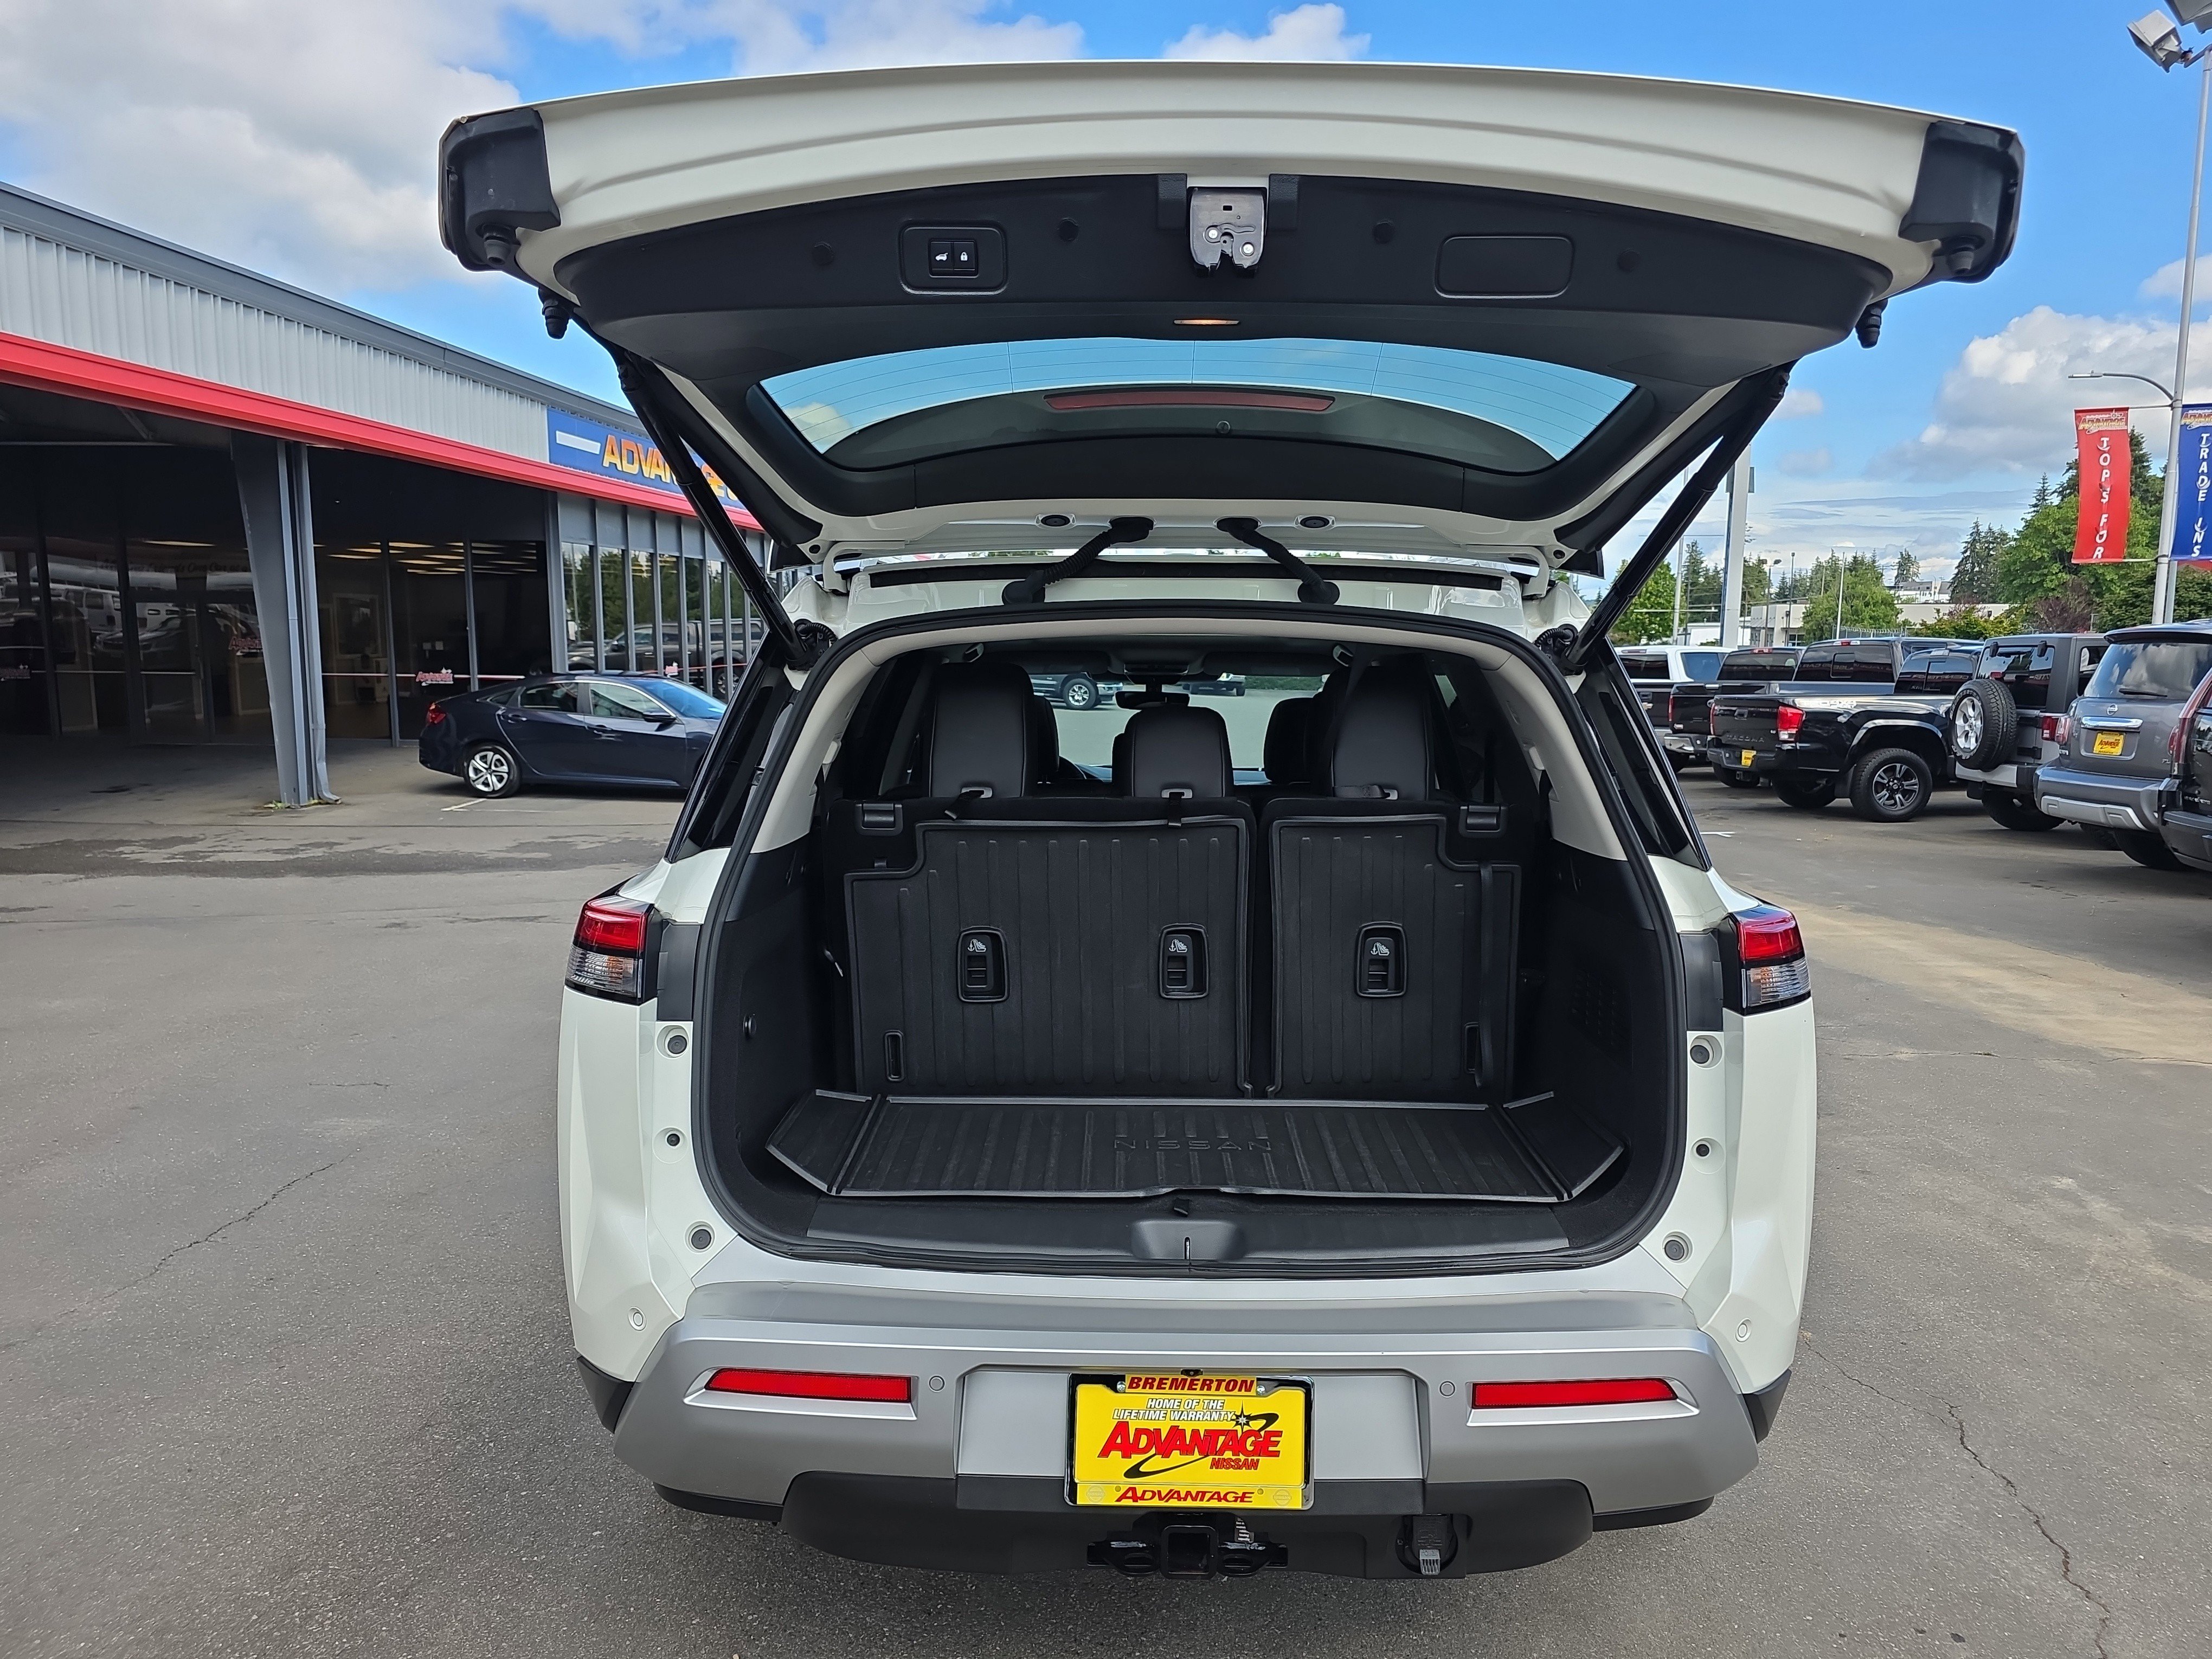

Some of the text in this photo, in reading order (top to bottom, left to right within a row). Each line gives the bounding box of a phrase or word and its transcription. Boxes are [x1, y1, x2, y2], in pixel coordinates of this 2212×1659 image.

[2078, 417, 2125, 430] ADVANTAGE
[2098, 437, 2111, 482] TOP
[2191, 433, 2211, 557] TRADE INS
[2093, 513, 2109, 560] FOR
[1114, 1139, 1272, 1150] NISSAN
[1127, 1376, 1255, 1393] BREMERTON
[1146, 1398, 1225, 1410] HOME OF THE
[1112, 1409, 1236, 1422] LIFETIME WARRANTY
[1097, 1420, 1283, 1459] ADVANTAGE
[1210, 1457, 1260, 1470] NISSAN
[1115, 1487, 1255, 1503] ADVANTAGE
